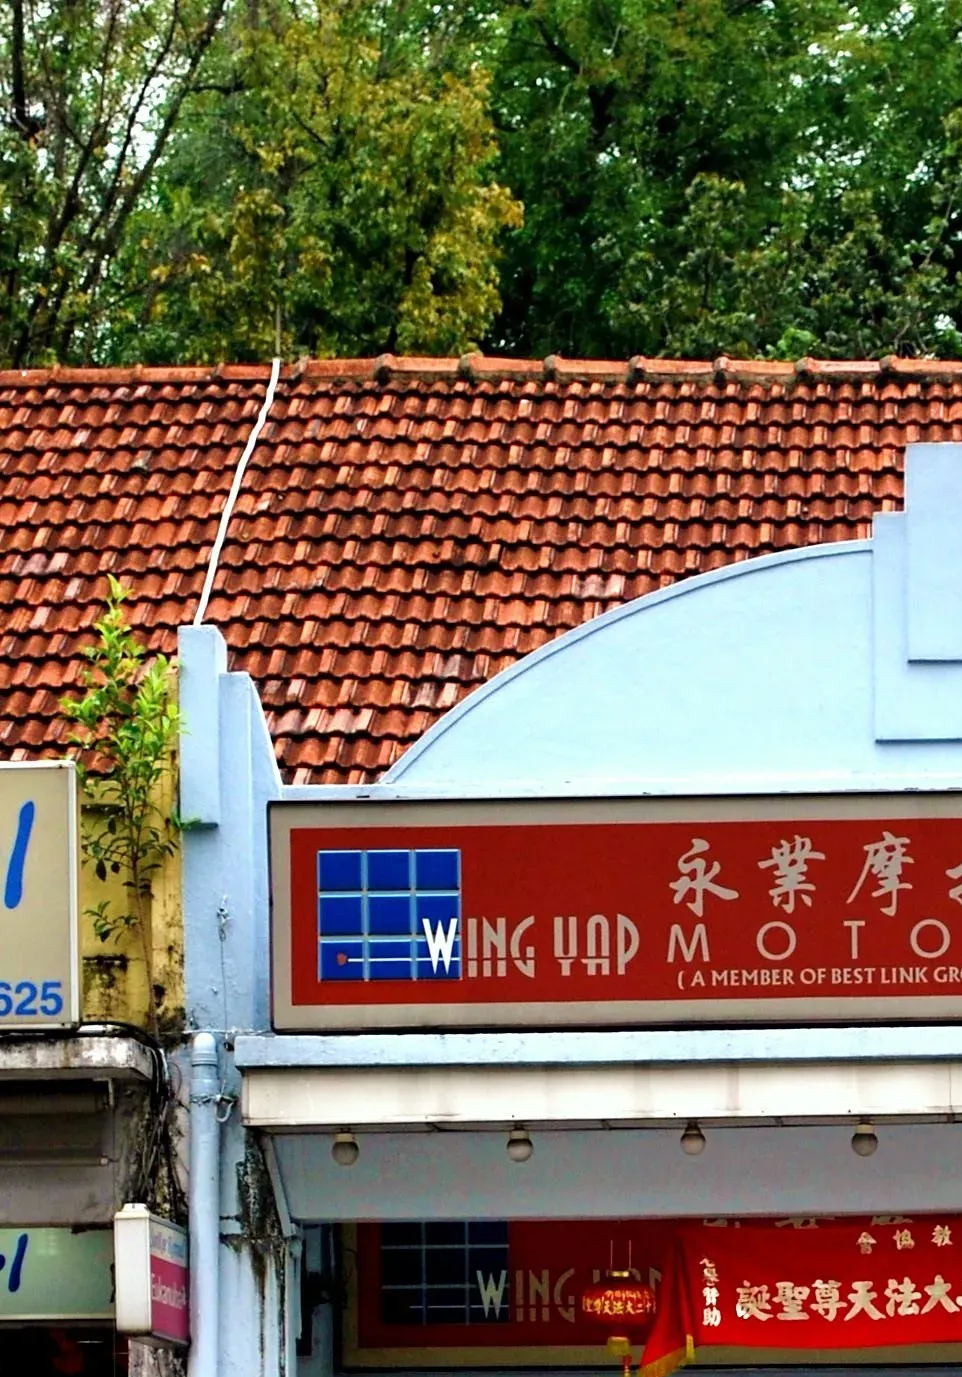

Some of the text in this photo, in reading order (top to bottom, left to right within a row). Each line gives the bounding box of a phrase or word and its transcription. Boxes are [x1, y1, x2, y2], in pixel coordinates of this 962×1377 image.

[422, 915, 535, 979] WING
[711, 969, 796, 987] MEMBER
[800, 968, 827, 985] OF
[830, 967, 877, 985] BEST
[881, 966, 929, 984] LINK
[475, 1268, 576, 1325] WING
